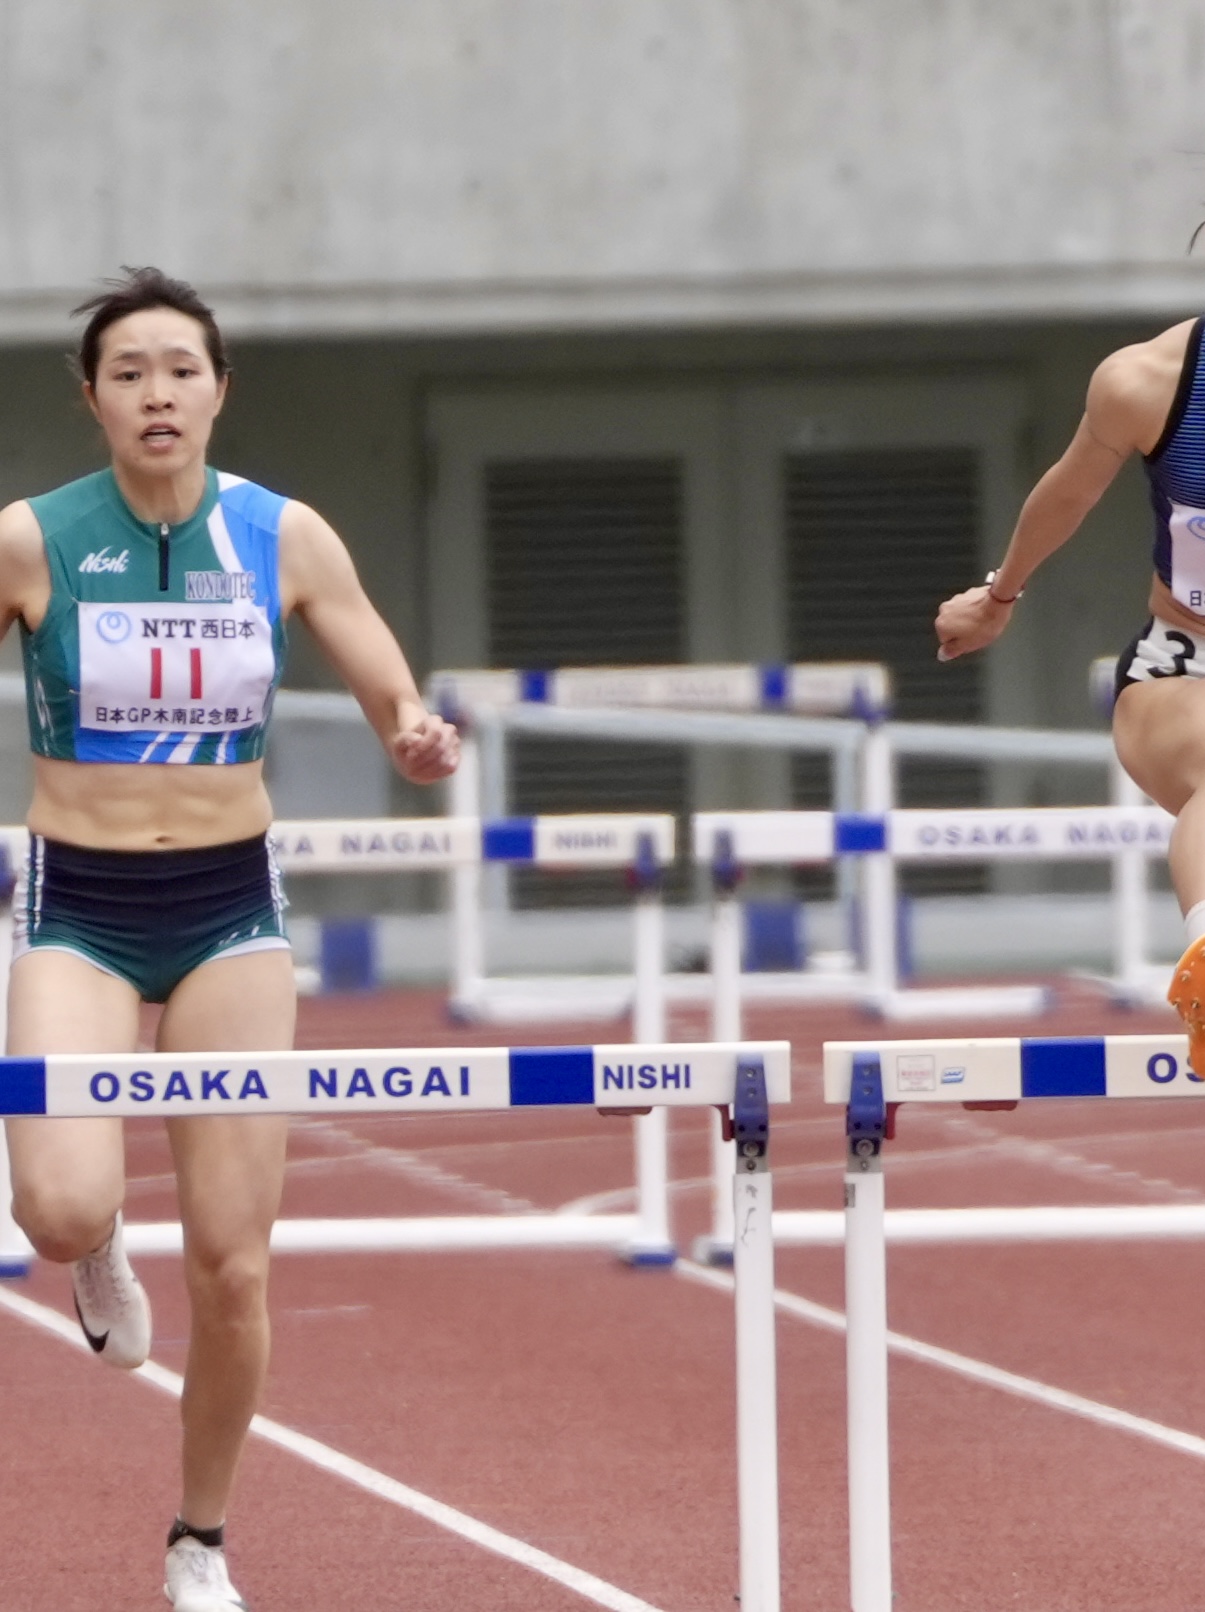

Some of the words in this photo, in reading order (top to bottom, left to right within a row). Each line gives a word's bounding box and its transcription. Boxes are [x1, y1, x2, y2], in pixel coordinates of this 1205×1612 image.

[185, 571, 256, 600] KONDOTEC
[150, 647, 202, 700] 11
[340, 832, 451, 855] NAGAI
[917, 824, 1041, 847] OSAKA
[89, 1069, 270, 1103] OSAKA
[308, 1066, 470, 1098] NAGAI
[602, 1064, 691, 1091] NISHI
